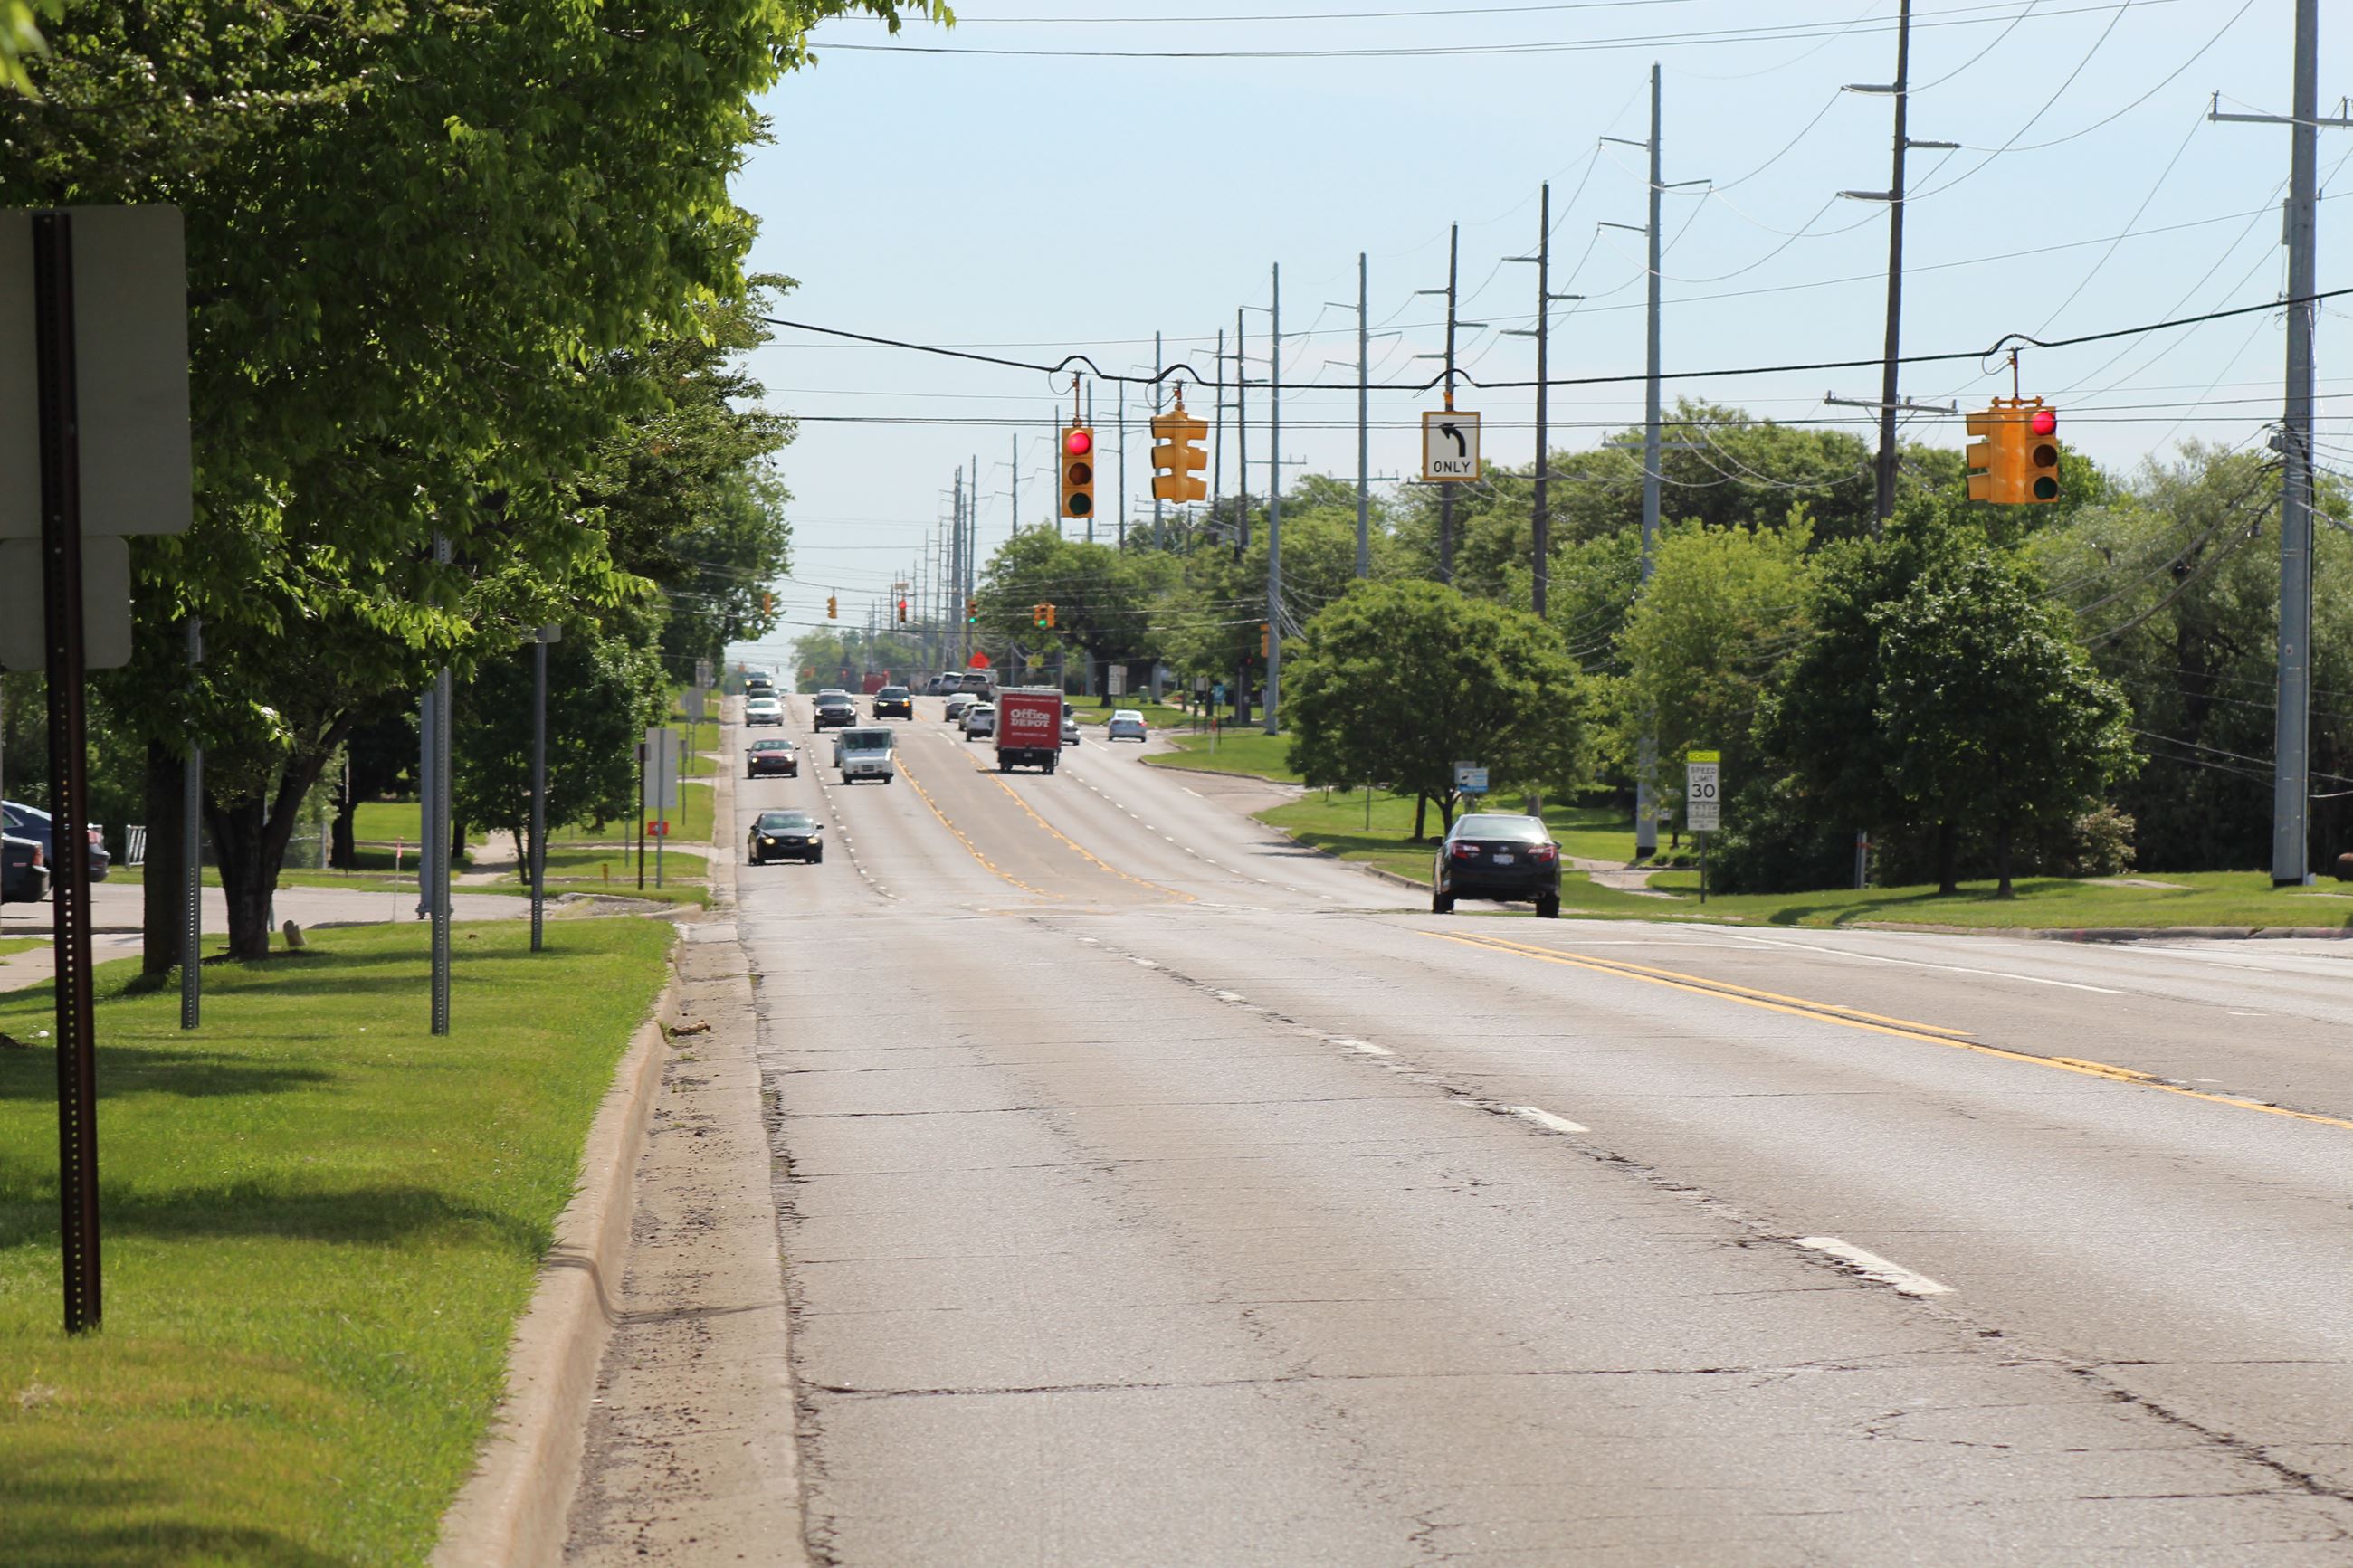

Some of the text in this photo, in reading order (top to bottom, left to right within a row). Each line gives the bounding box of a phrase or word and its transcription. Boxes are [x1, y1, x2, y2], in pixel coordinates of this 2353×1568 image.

[1434, 461, 1471, 473] ONLY
[1010, 708, 1050, 720] Office
[1010, 718, 1050, 727] DEPOT
[1691, 766, 1716, 774] SPEED
[1692, 784, 1715, 798] 30
